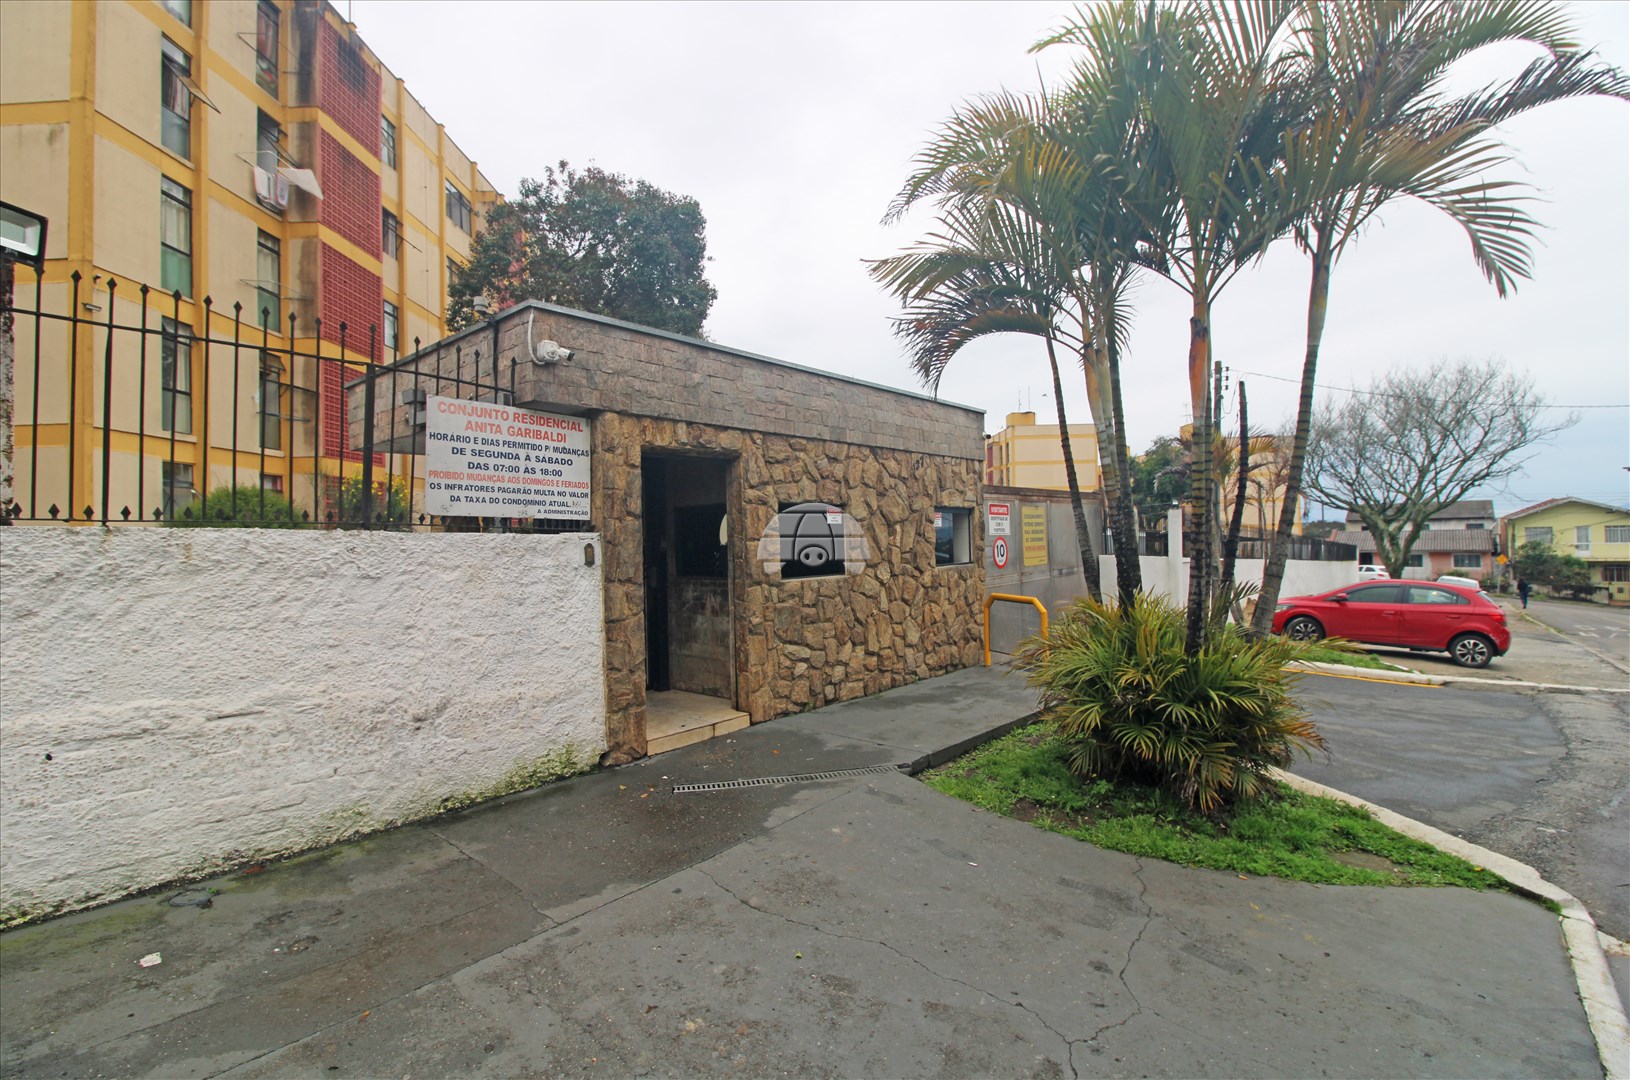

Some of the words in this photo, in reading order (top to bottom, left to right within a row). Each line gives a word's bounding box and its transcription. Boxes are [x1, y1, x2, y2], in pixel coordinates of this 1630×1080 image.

[438, 402, 510, 421] CONJUNTO
[513, 412, 583, 432] RESIDENCIAL
[465, 420, 502, 435] ANITA
[507, 426, 566, 443] GARIBALDI
[429, 432, 470, 444] HORÁRIO
[482, 438, 500, 447] DIAS
[502, 440, 542, 451] PERMITIDO
[553, 446, 589, 457] MUDANÇAS
[452, 447, 466, 456] DE
[471, 448, 520, 460] SEGUNDA
[534, 454, 573, 466] SÁBADO
[468, 462, 489, 470] DAS
[493, 464, 520, 472] 07:00
[540, 467, 562, 476] 18:00
[428, 470, 464, 480] PROIBIDO
[467, 473, 505, 484] MUDANÇAS
[507, 476, 520, 484] AOS
[522, 477, 554, 486] DOMINGOS
[561, 480, 589, 489] FERIADOS
[429, 482, 442, 490] OS
[444, 484, 495, 492] INFRATORES
[498, 486, 532, 495] PAGARÃO
[548, 500, 572, 508] ATUAL.
[996, 544, 1005, 558] 10
